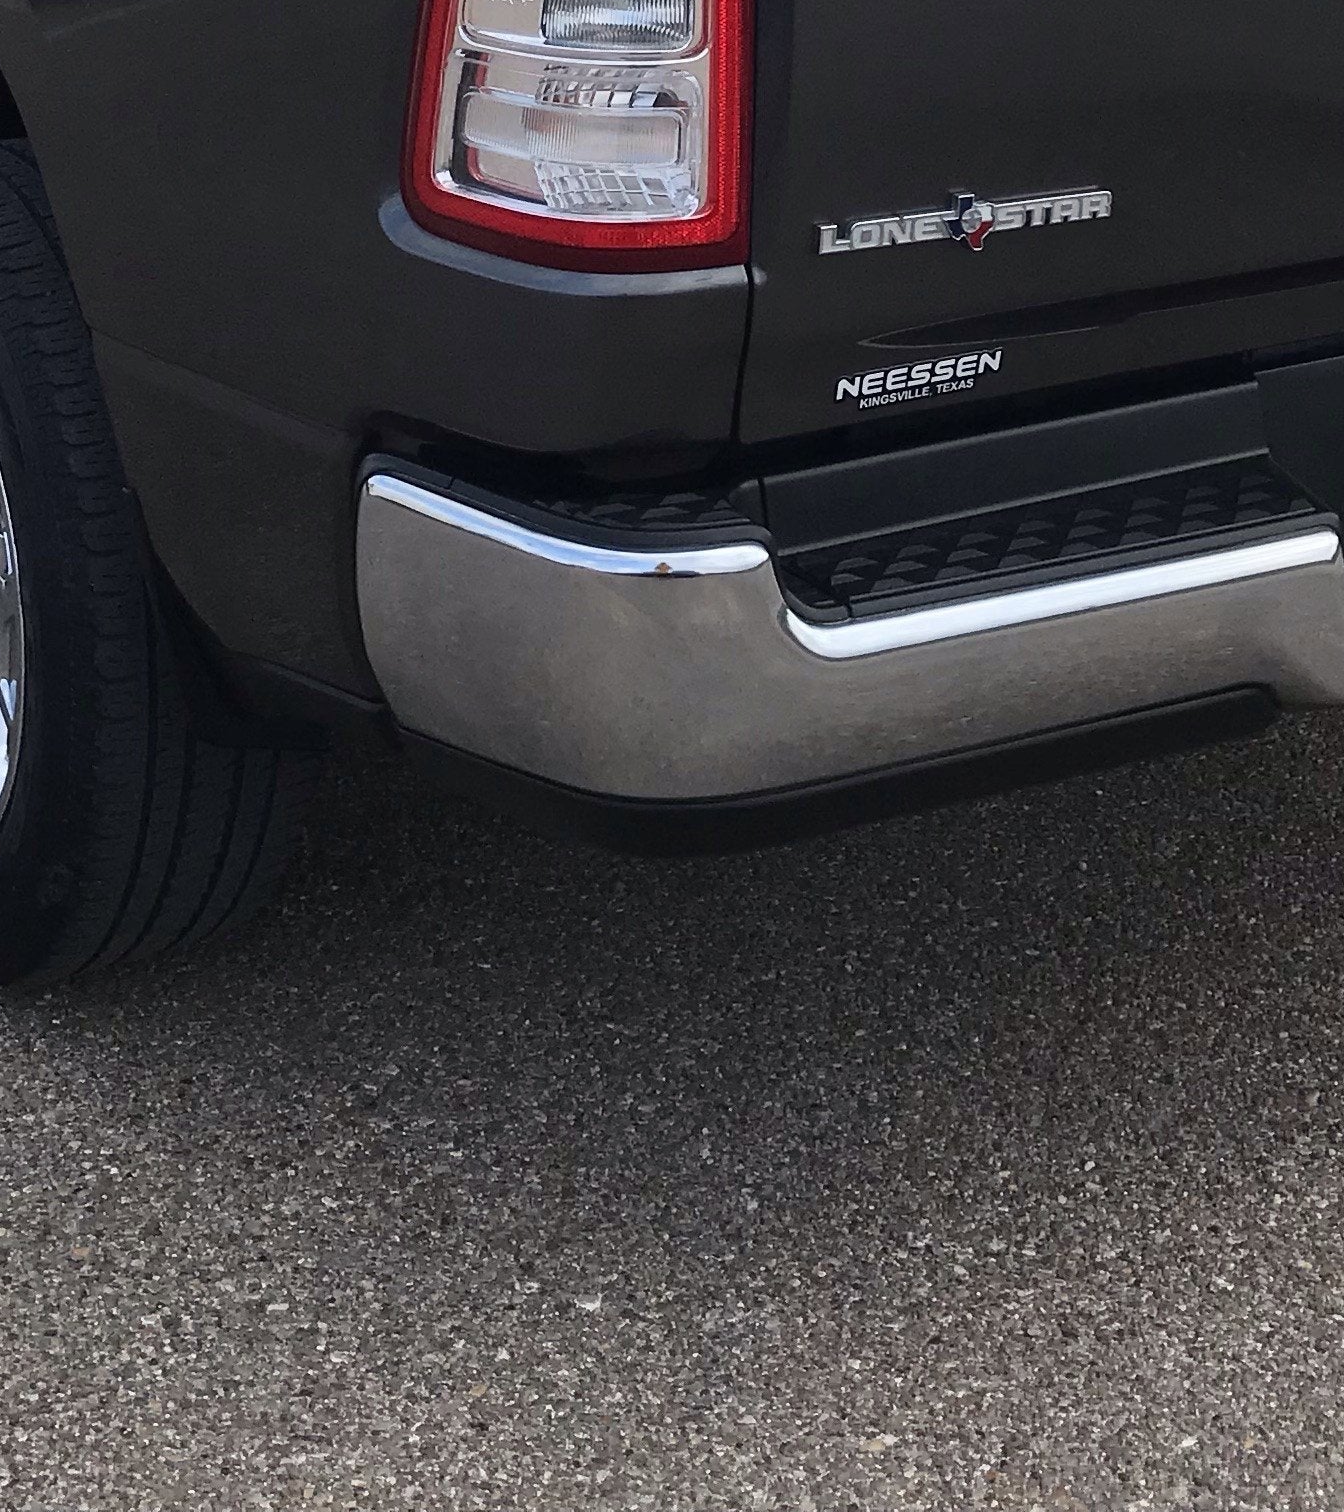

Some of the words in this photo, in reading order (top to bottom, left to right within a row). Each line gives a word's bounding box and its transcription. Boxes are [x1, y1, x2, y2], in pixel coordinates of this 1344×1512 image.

[819, 210, 952, 255] LONE
[992, 190, 1113, 232] STAR
[835, 350, 1003, 401] NEESSEN
[859, 386, 934, 409] KINGSVILLE,
[936, 378, 975, 395] TEXAS
